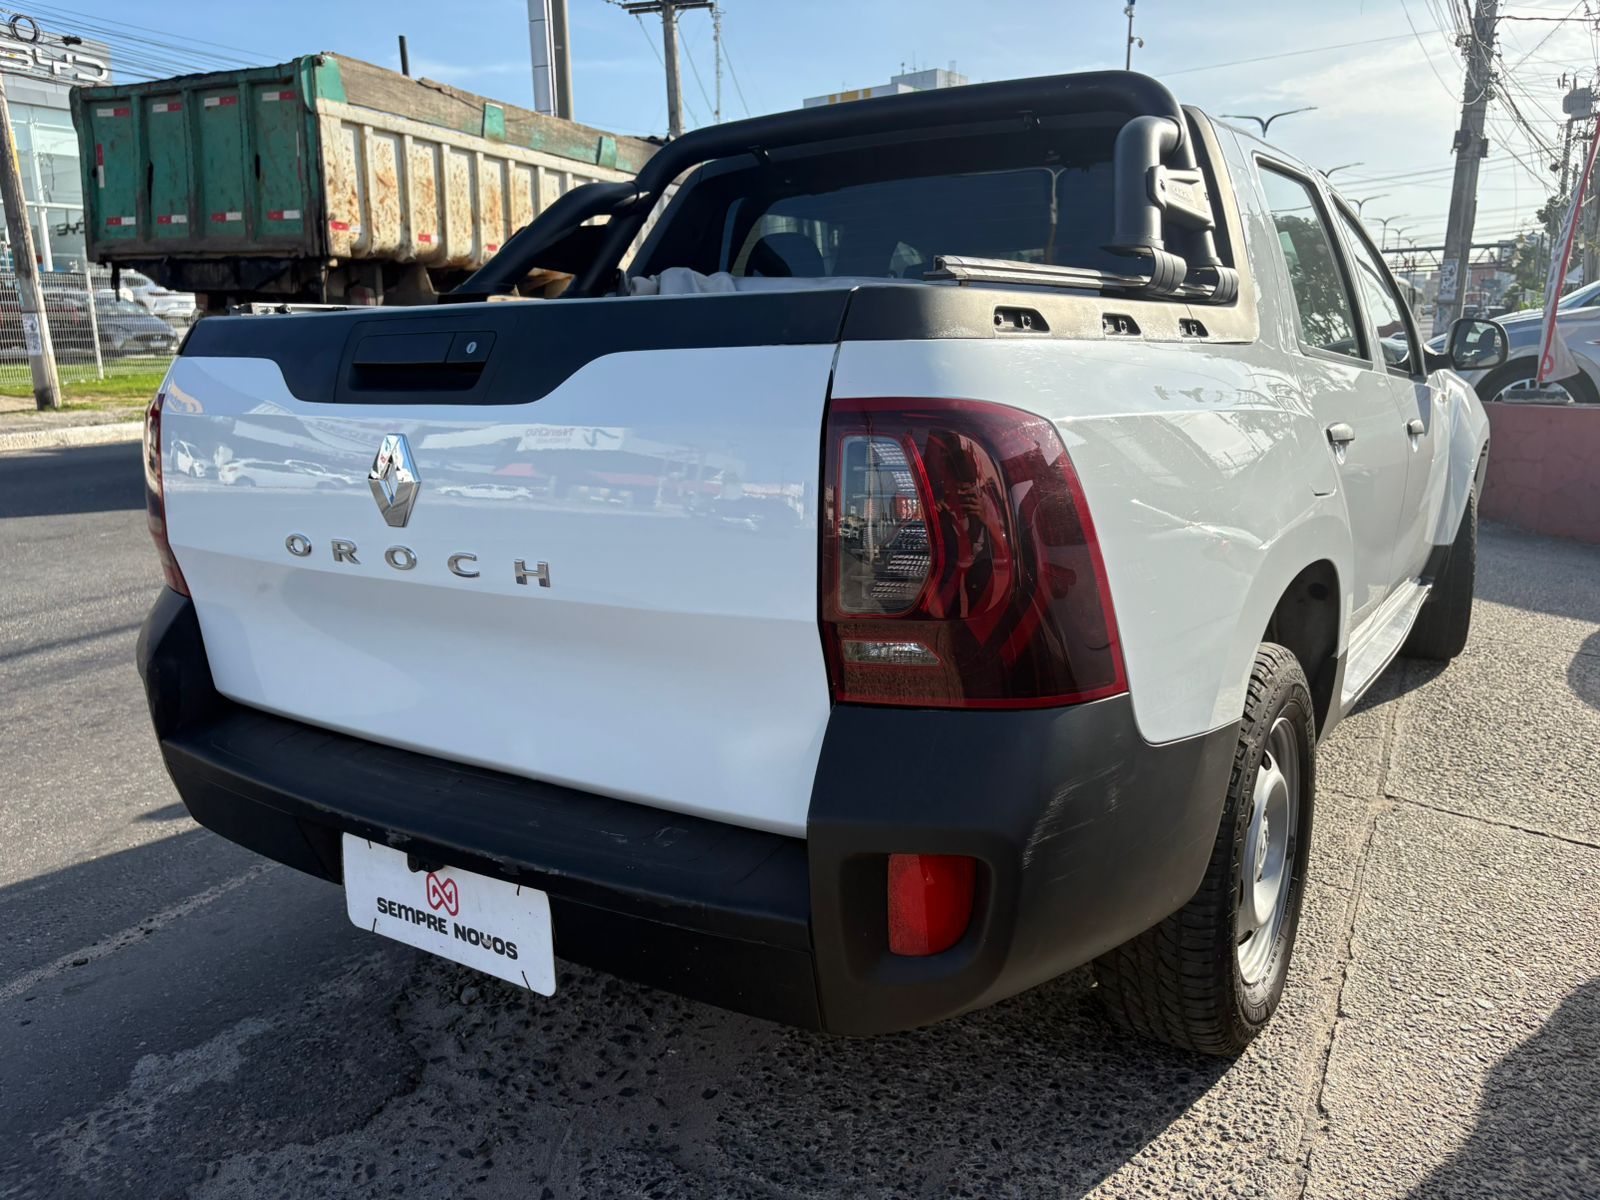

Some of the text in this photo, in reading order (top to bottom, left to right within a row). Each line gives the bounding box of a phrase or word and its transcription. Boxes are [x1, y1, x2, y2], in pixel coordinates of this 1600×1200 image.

[285, 533, 551, 588] OROCH
[376, 896, 518, 960] SEMPRE NOVOS
